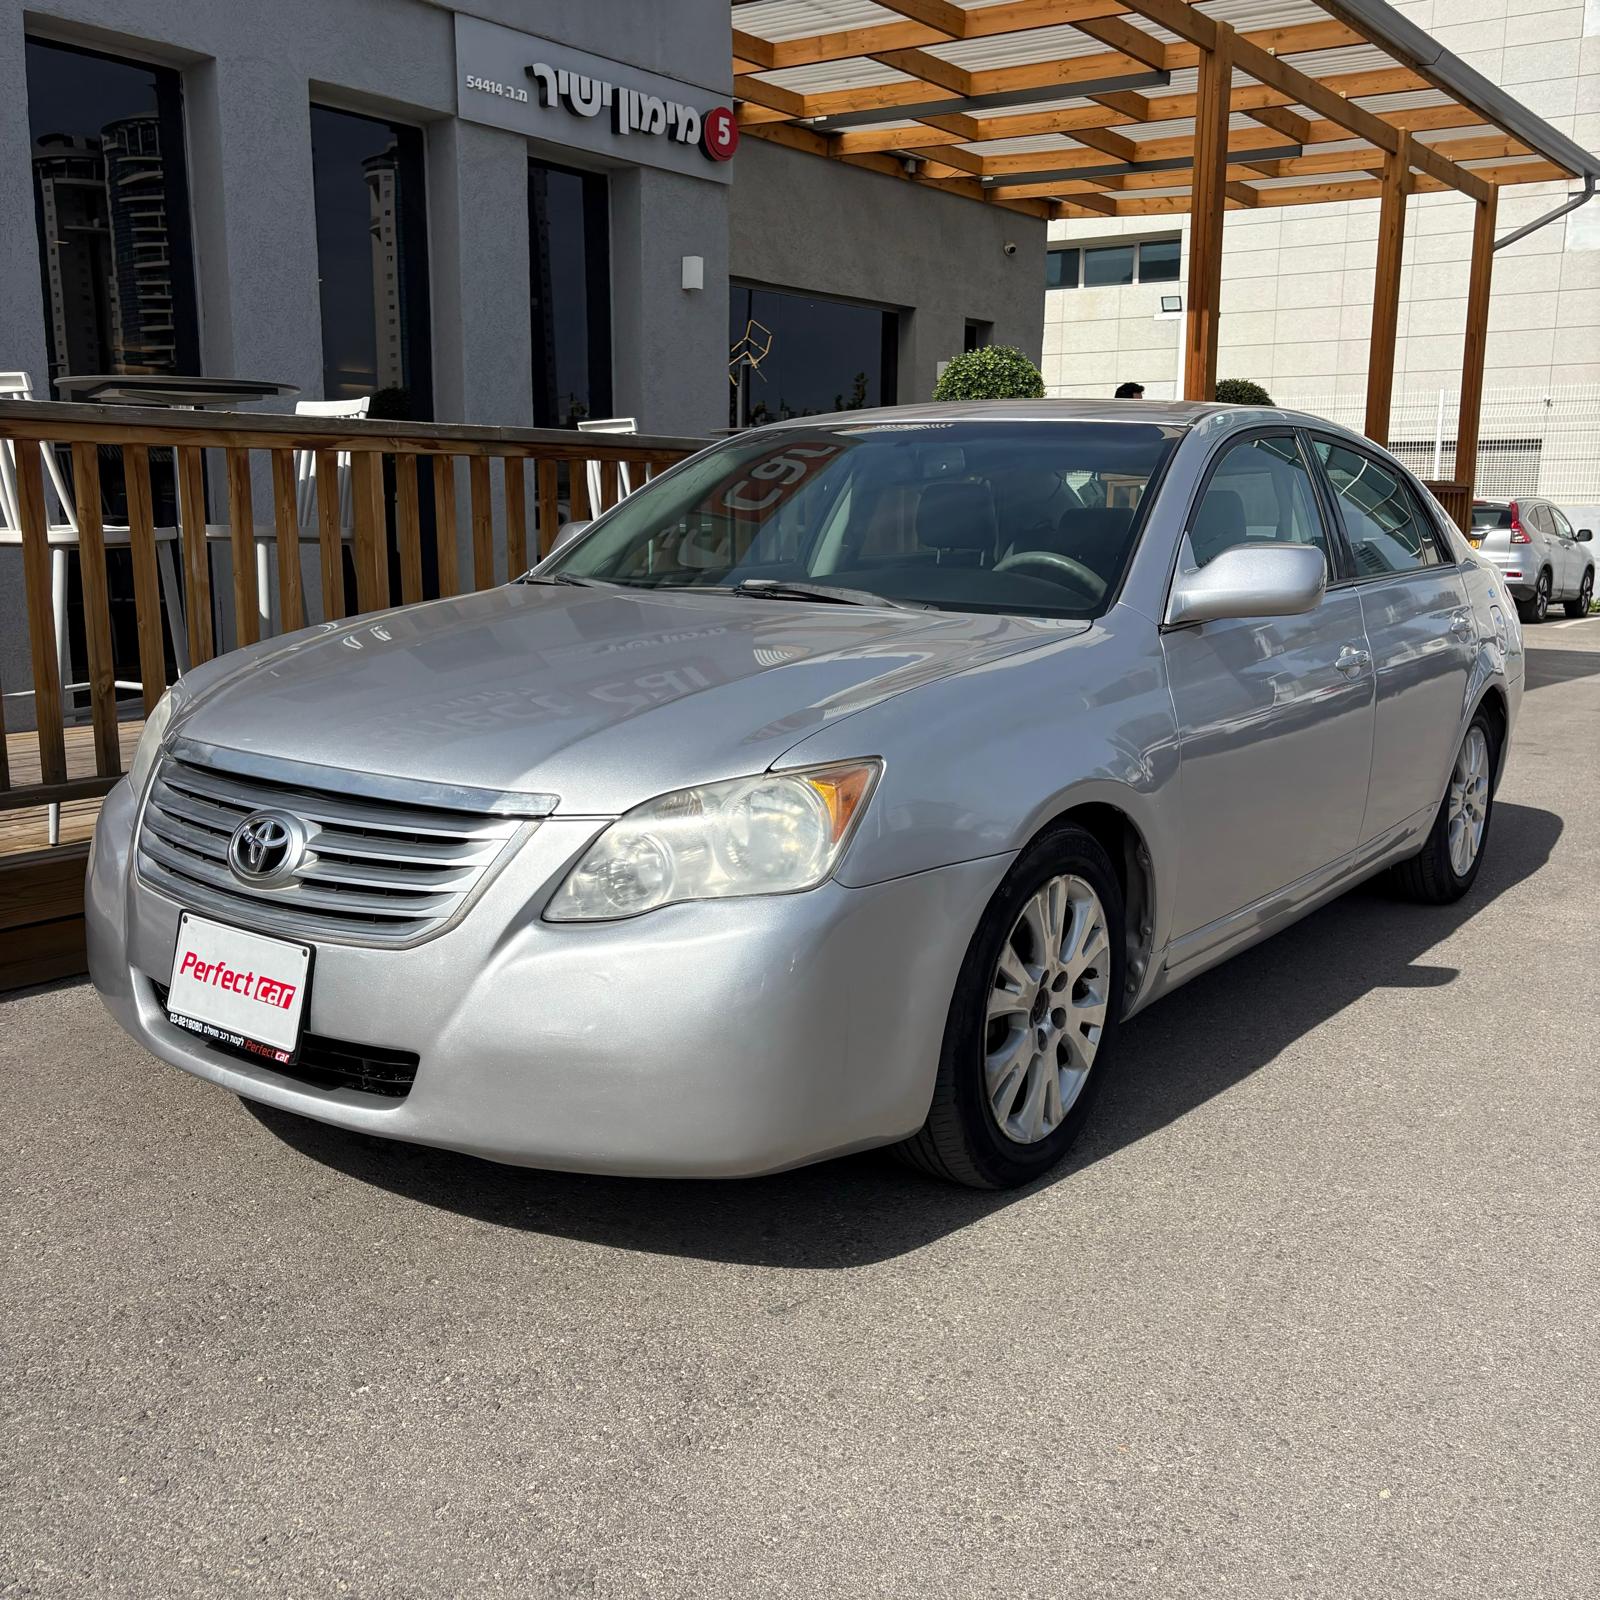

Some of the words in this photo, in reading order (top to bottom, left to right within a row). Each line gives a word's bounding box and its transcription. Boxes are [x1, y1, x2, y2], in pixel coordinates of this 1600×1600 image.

[466, 75, 503, 96] 54414
[530, 62, 612, 117] ישיר
[618, 87, 701, 145] מימון
[718, 117, 730, 146] 5
[180, 951, 254, 997] Perfect
[255, 979, 294, 1008] car
[245, 1039, 275, 1057] Perfect
[275, 1050, 290, 1064] car
